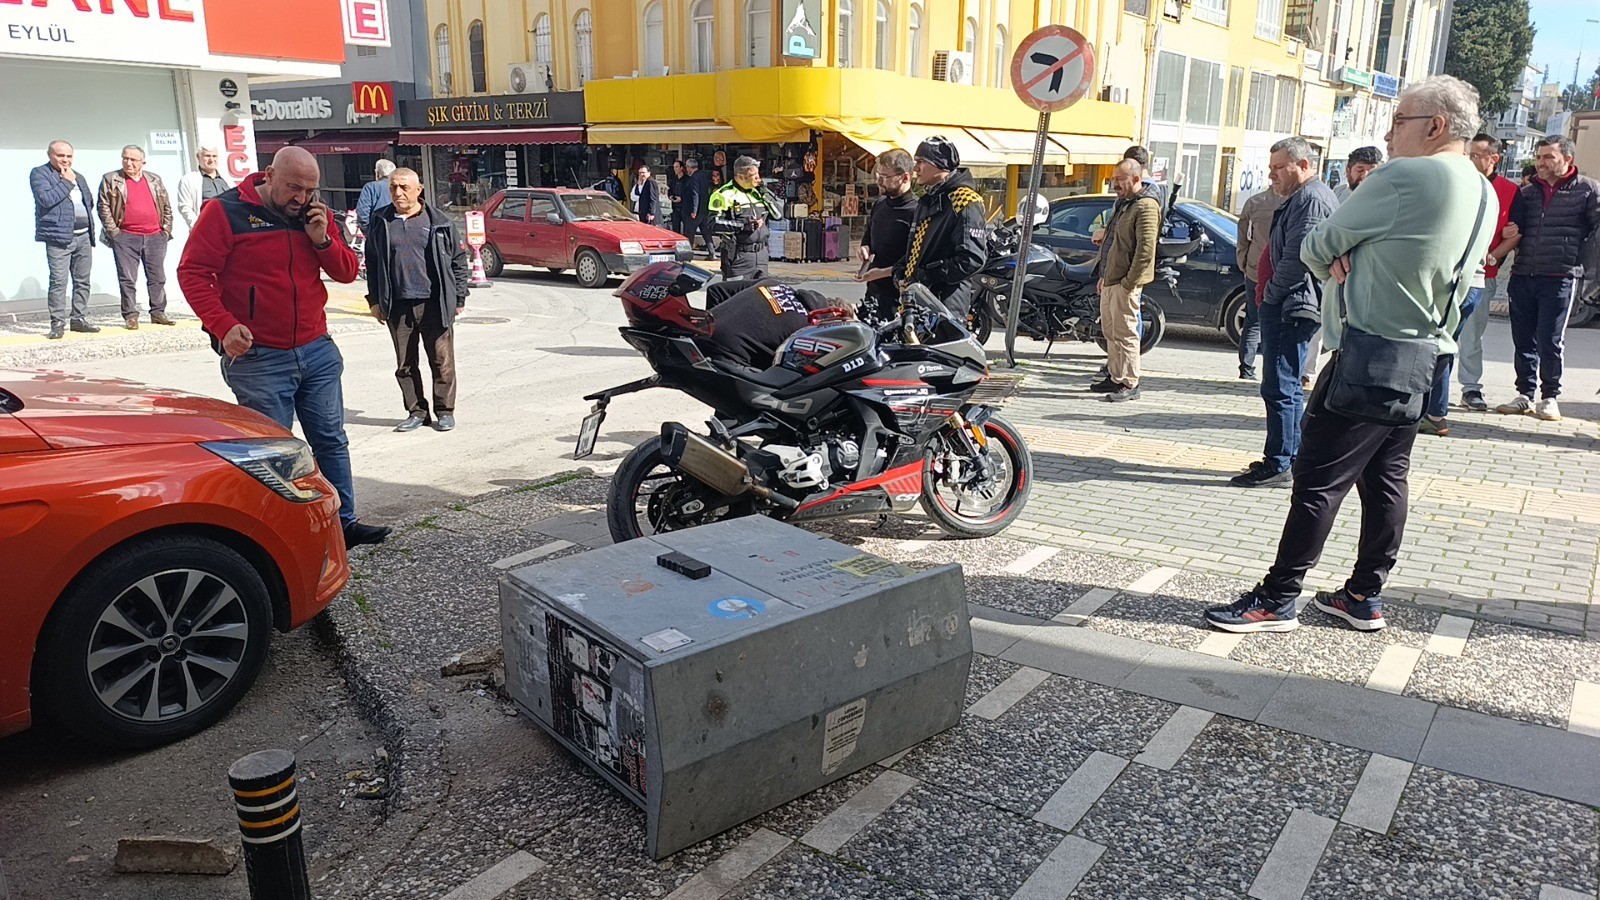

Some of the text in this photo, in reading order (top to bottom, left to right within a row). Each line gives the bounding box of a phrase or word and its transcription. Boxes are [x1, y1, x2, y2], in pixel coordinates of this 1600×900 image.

[354, 2, 378, 35] E
[8, 24, 75, 43] EYLÜL
[428, 97, 548, 126] ŞIK GİYİM & TERZİ
[638, 291, 667, 300] 1968
[842, 357, 865, 373] DID
